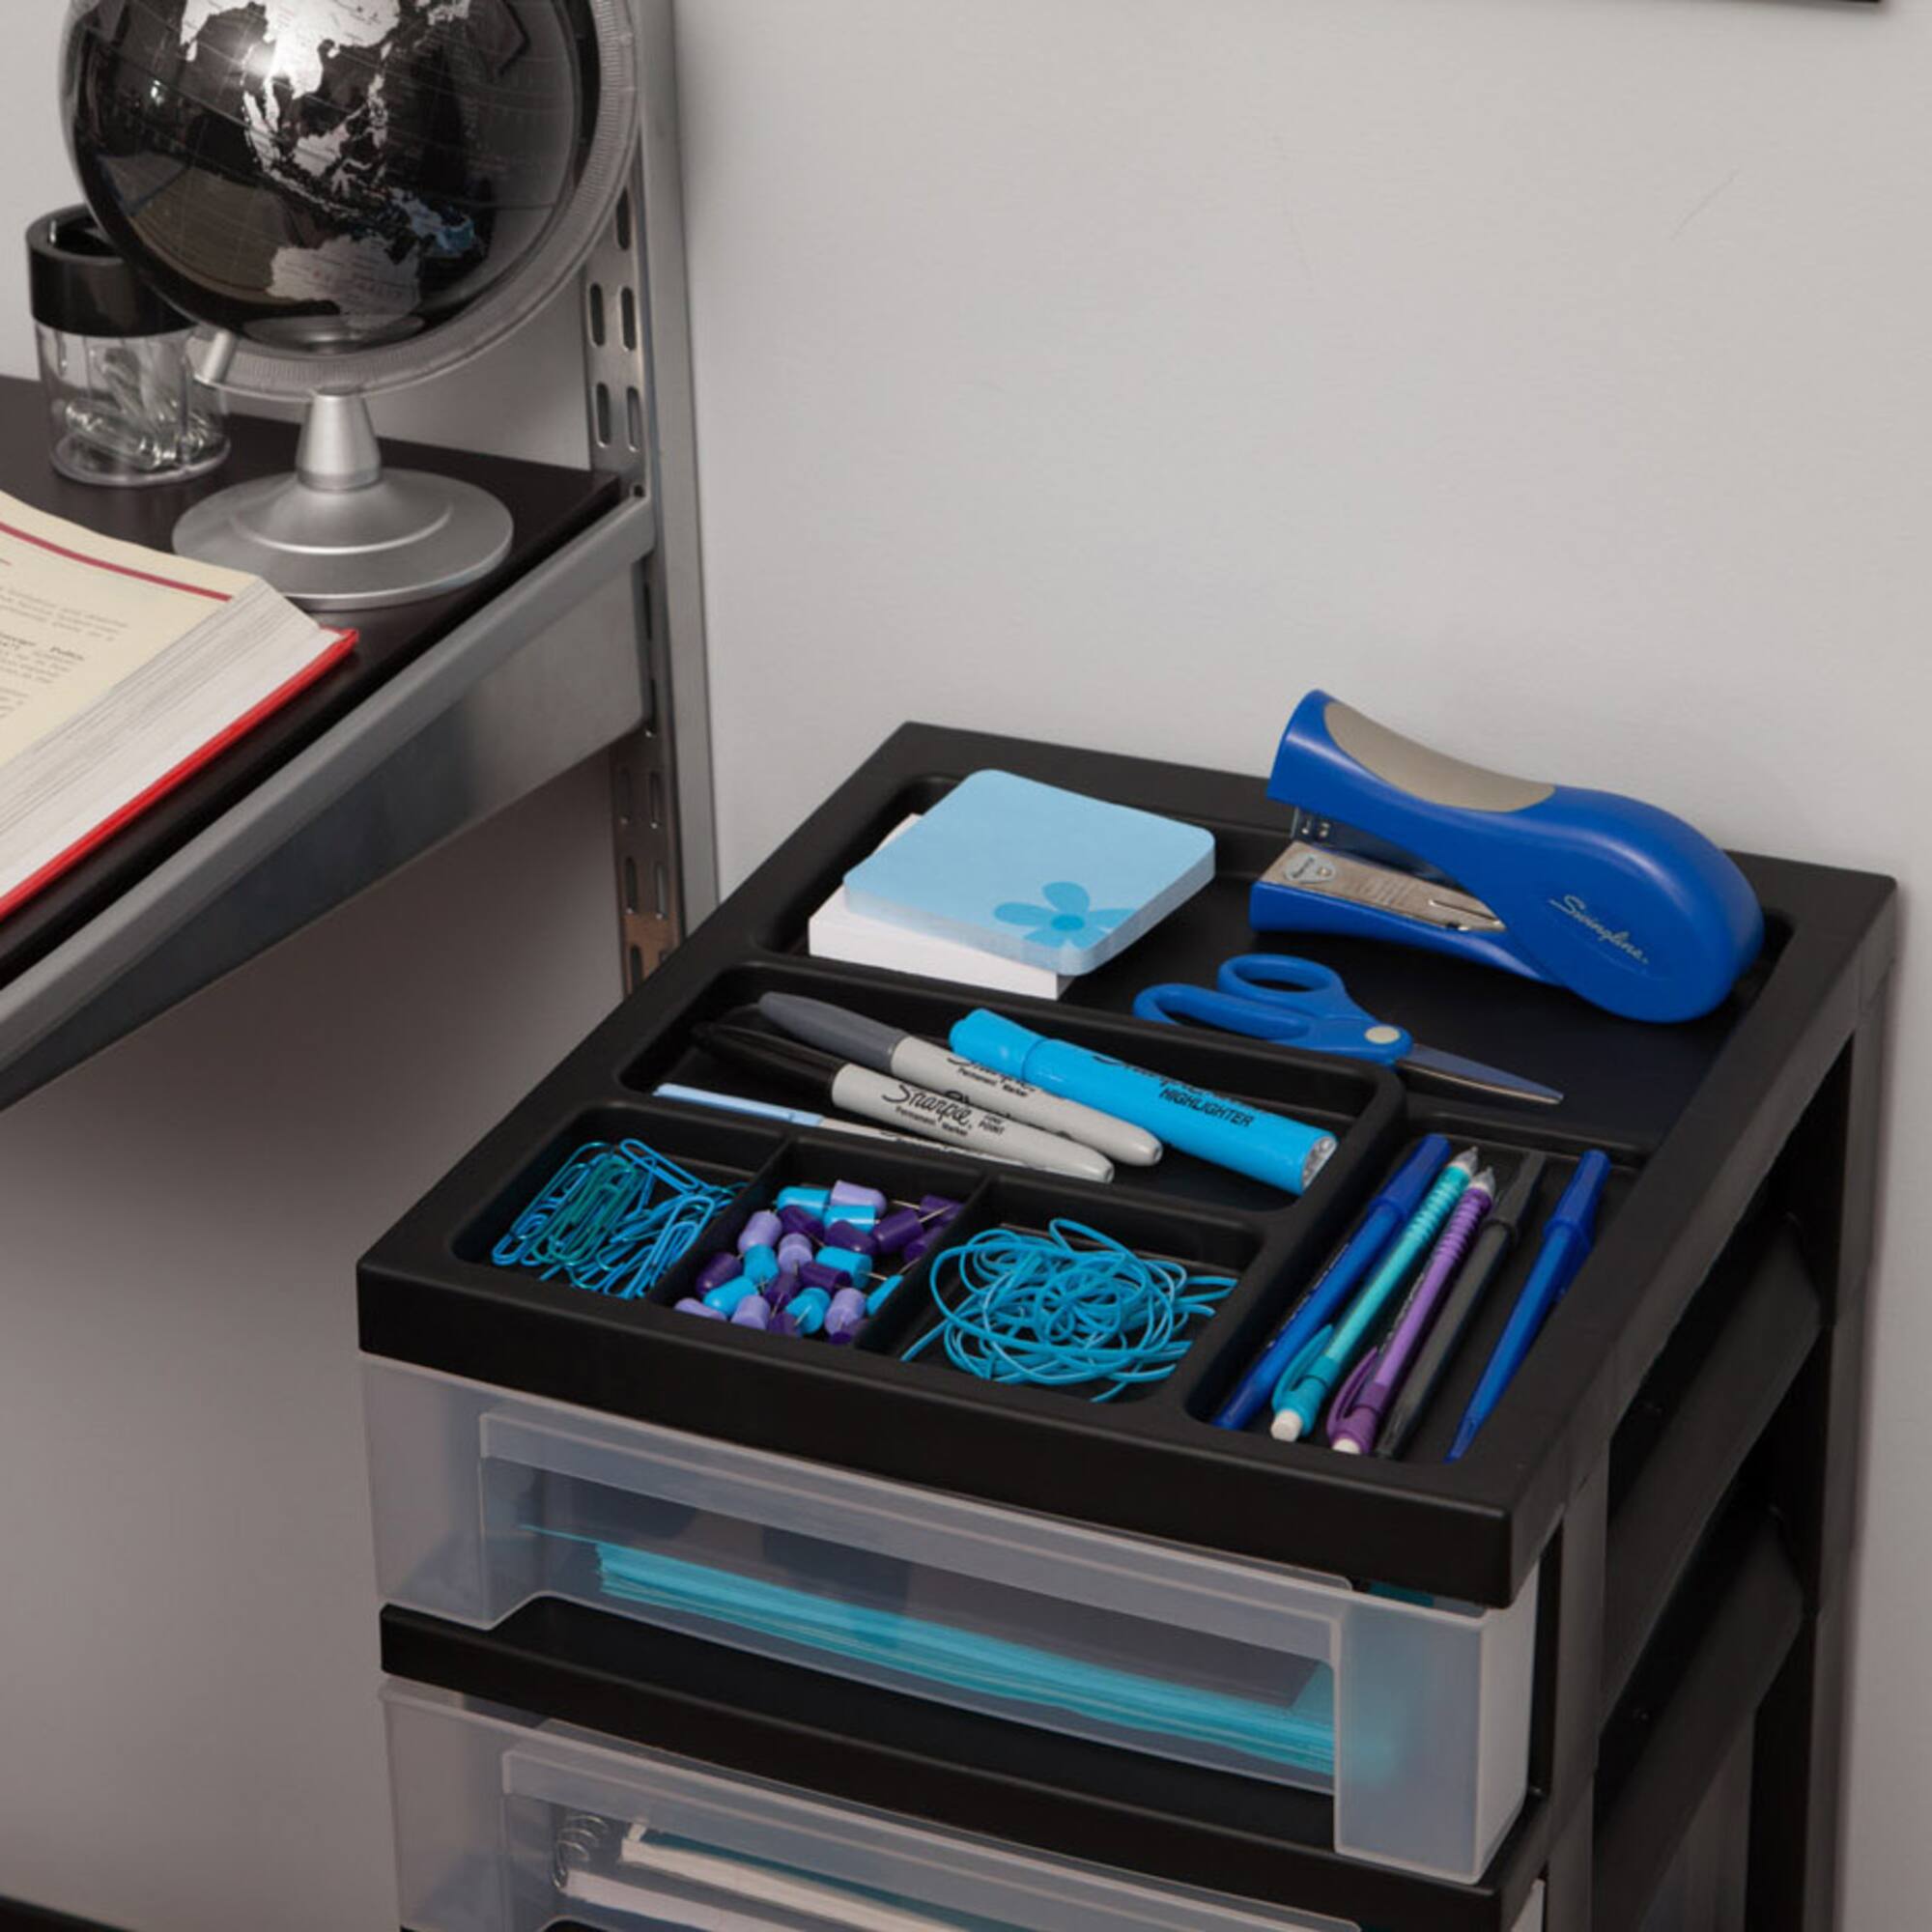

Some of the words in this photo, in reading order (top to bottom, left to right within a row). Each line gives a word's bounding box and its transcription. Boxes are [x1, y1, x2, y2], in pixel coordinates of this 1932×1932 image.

[1548, 895, 1644, 961] Swingline
[882, 1084, 972, 1126] Sharpie
[1159, 1088, 1255, 1127] HIGHLIGHTER
